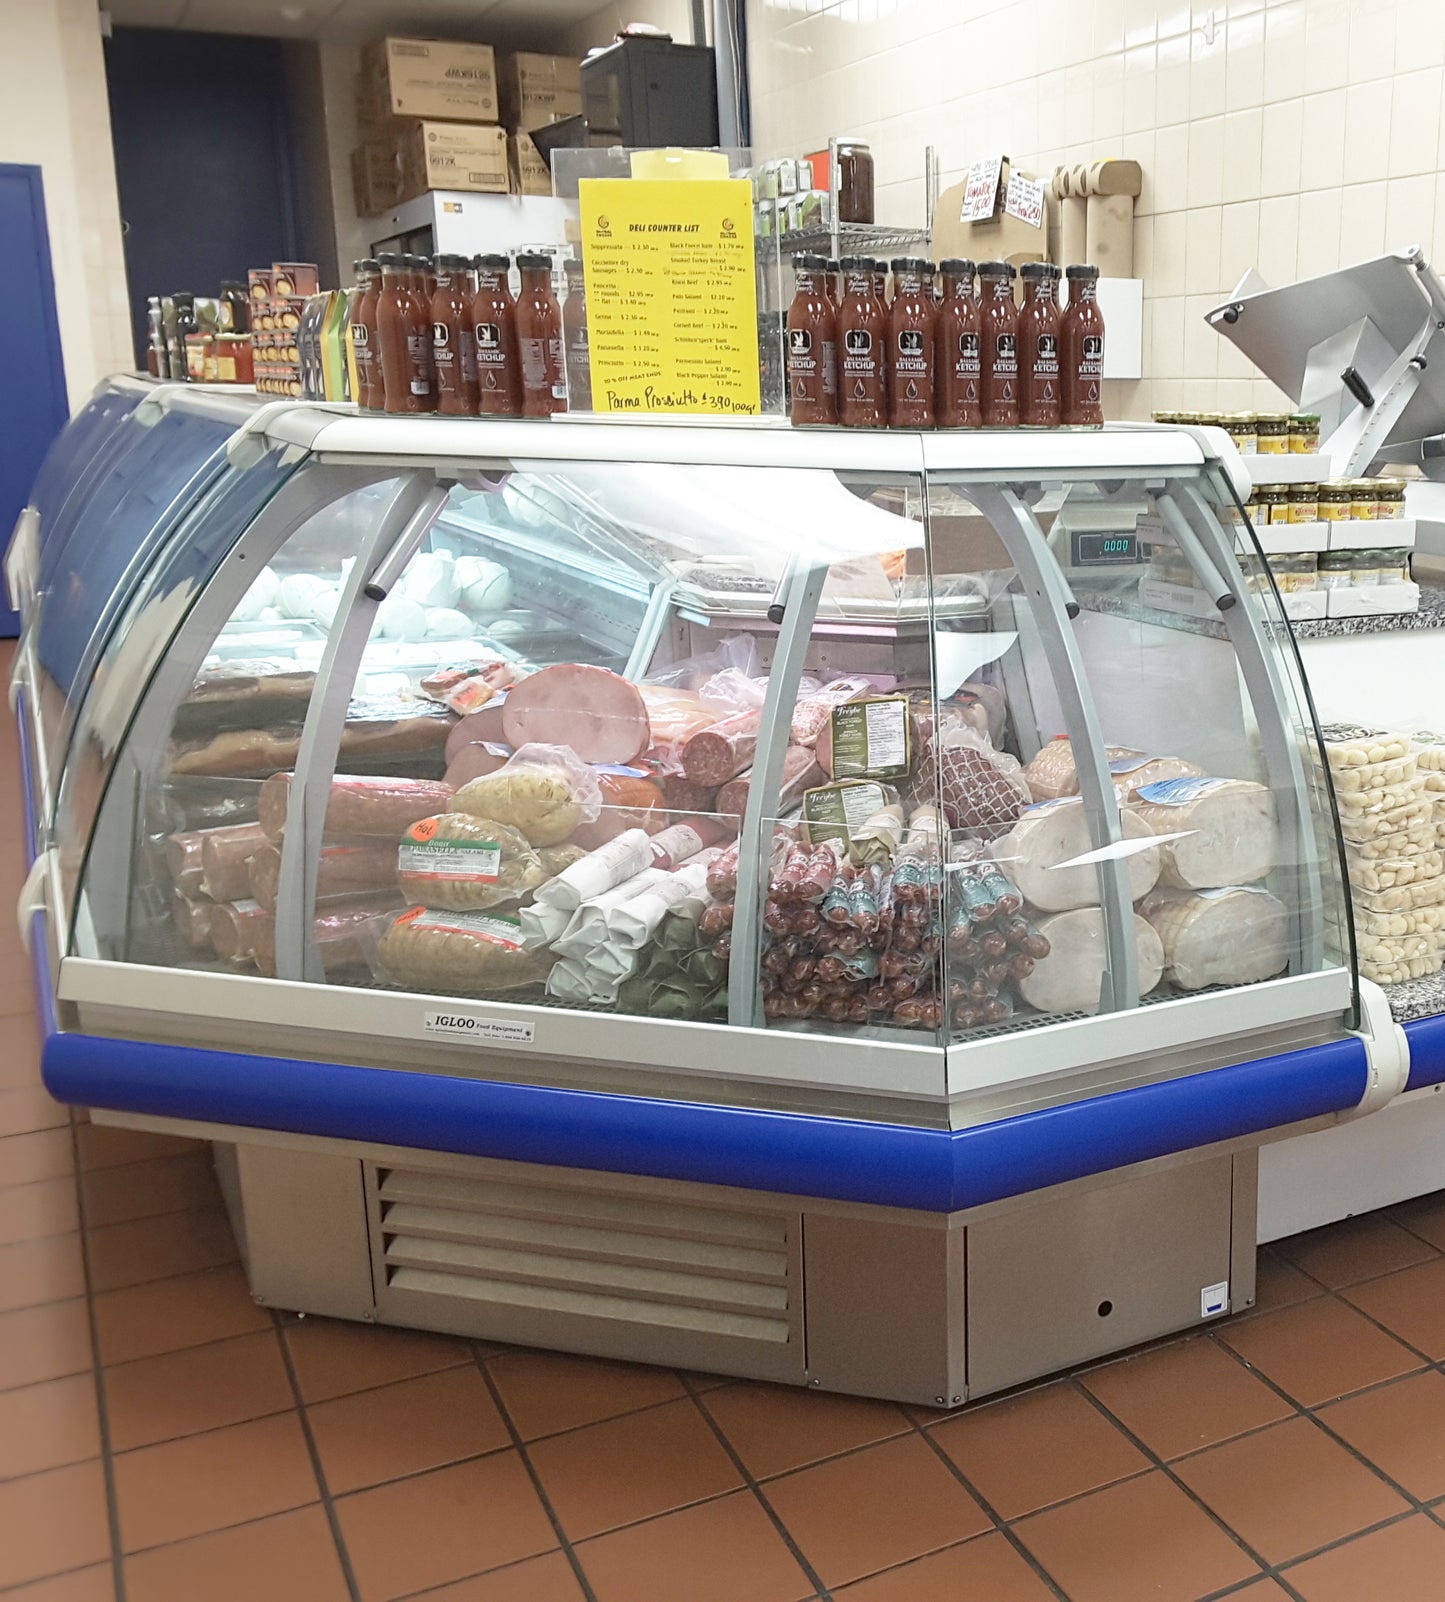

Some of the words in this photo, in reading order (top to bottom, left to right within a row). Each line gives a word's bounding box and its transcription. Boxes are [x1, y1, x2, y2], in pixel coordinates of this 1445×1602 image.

[629, 224, 646, 232] DELI
[648, 224, 682, 233] COUNTER
[684, 225, 700, 233] LIST
[843, 361, 876, 370] KETCHUP
[895, 361, 928, 371] KETCHUP
[606, 390, 641, 411] Parma
[644, 386, 698, 409] Prosciutto
[836, 706, 862, 717] Freybe
[809, 791, 837, 804] Freybe
[435, 1015, 475, 1029] IGLOO
[491, 1024, 523, 1033] Equipment
